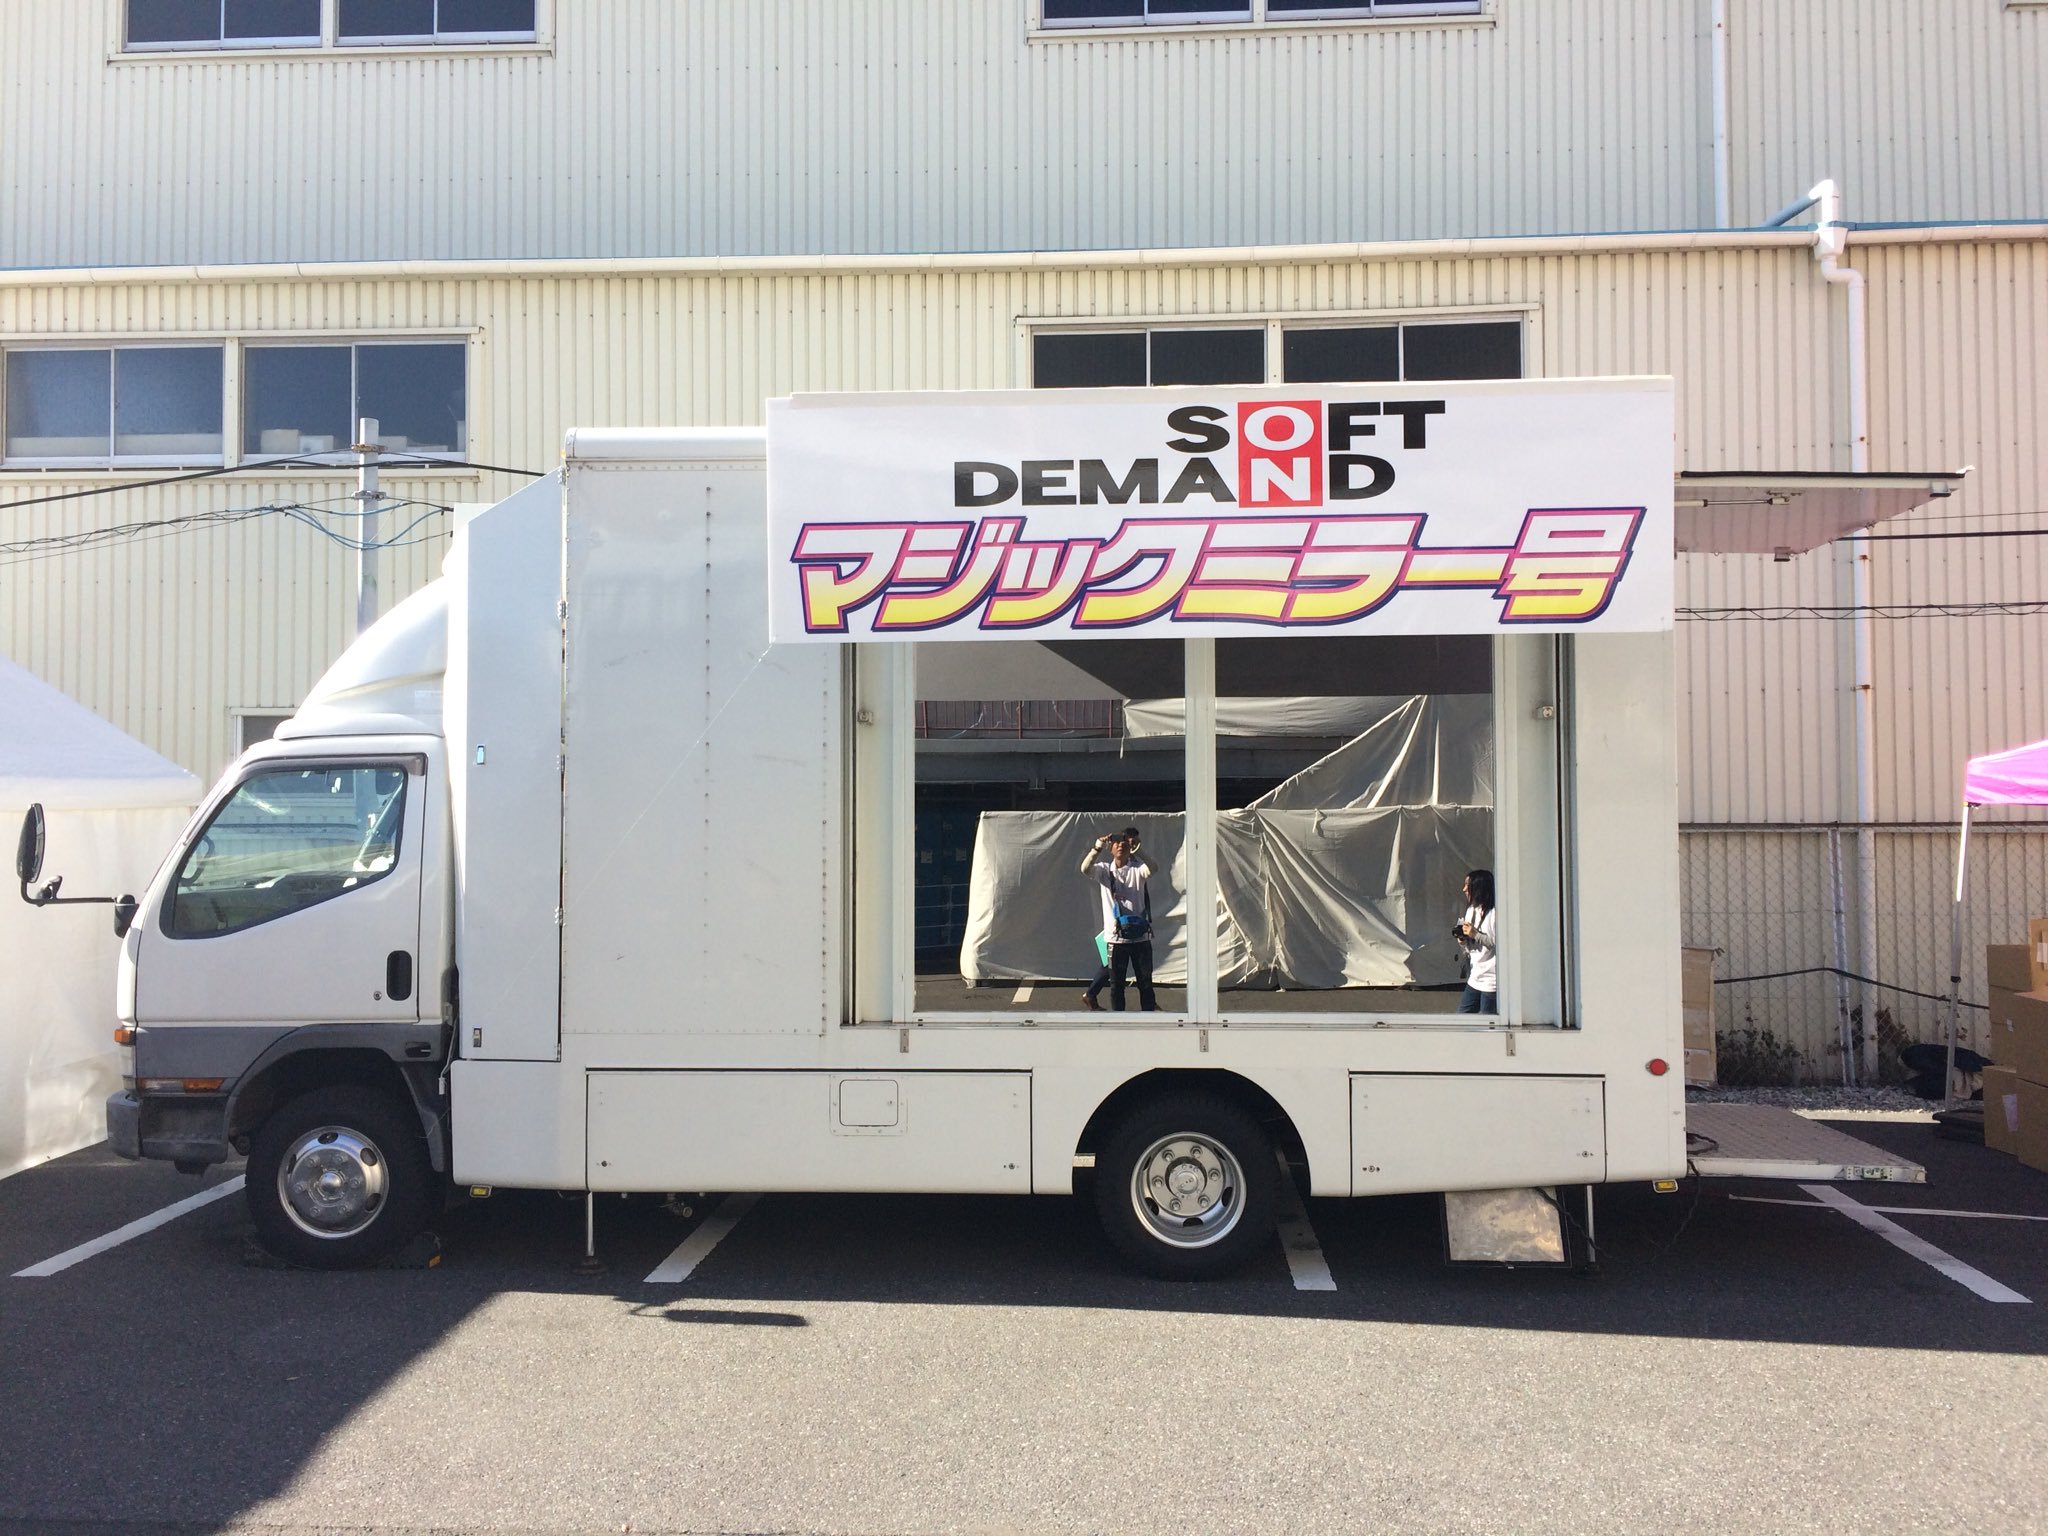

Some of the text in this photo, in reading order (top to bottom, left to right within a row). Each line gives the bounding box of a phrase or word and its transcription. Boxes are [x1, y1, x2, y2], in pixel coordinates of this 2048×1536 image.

[1166, 400, 1446, 453] SOFT
[954, 455, 1396, 507] DEMAND
[791, 507, 1646, 634] マジックミラー号
